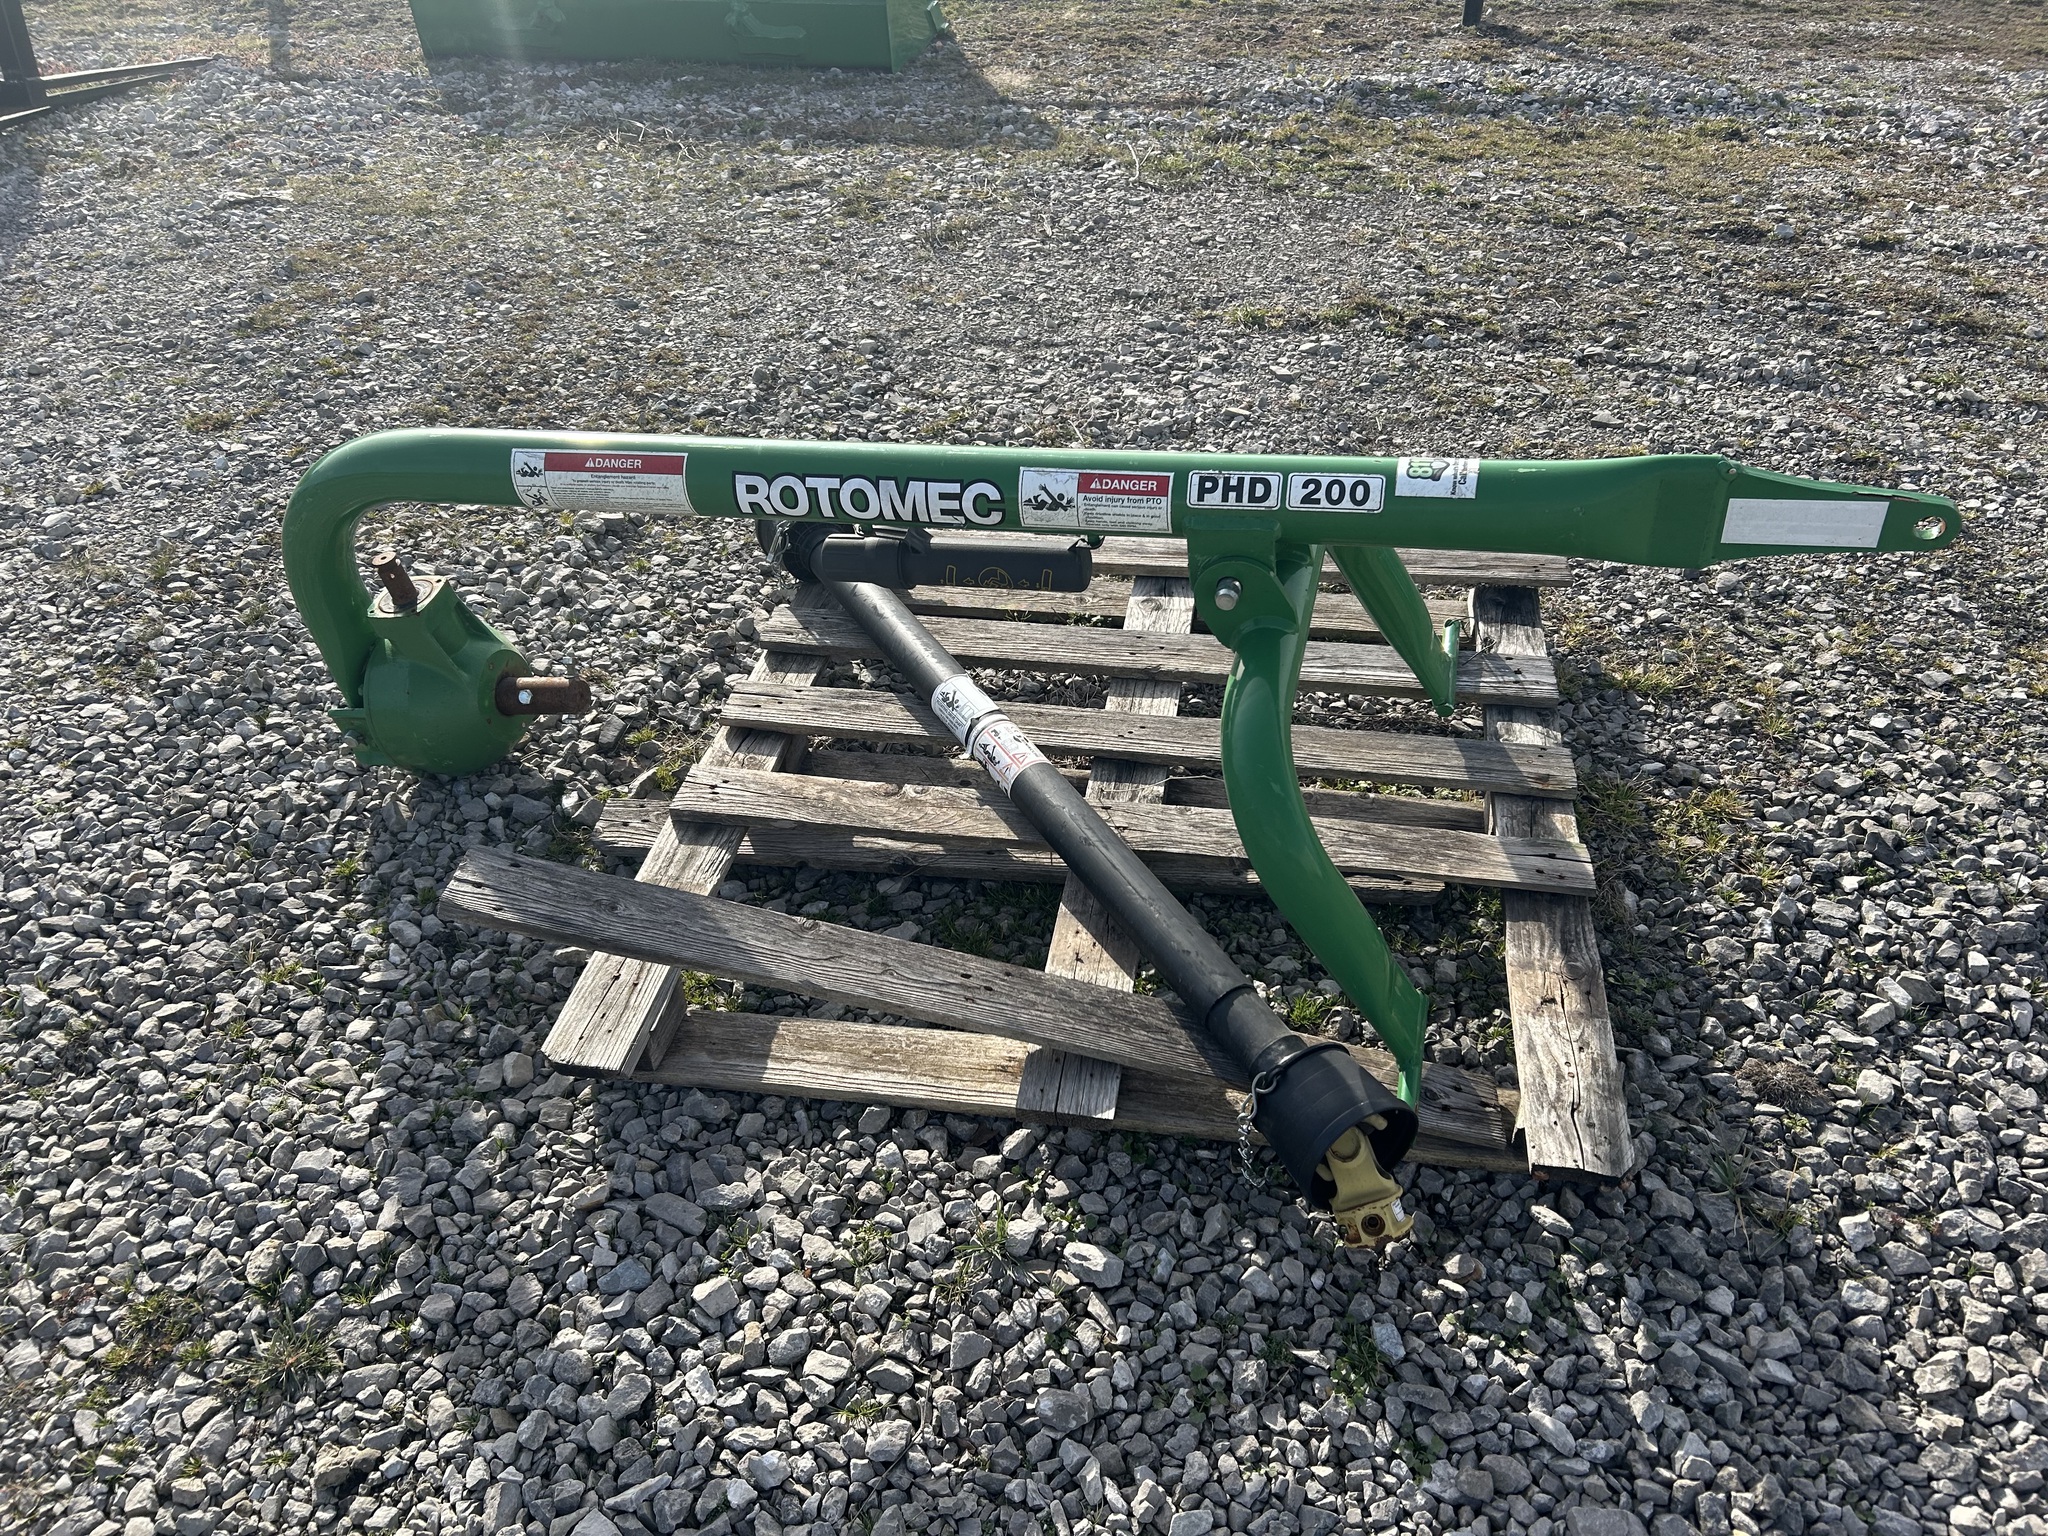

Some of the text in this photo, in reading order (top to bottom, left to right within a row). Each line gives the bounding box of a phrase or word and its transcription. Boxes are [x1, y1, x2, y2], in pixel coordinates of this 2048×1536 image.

[595, 458, 642, 469] DANGER
[1101, 478, 1158, 491] DANGER
[1196, 475, 1272, 504] PHD
[1300, 478, 1371, 507] 200
[733, 472, 1005, 526] ROTOMEC
[1083, 495, 1104, 503] Avoid
[1105, 496, 1125, 504] injury
